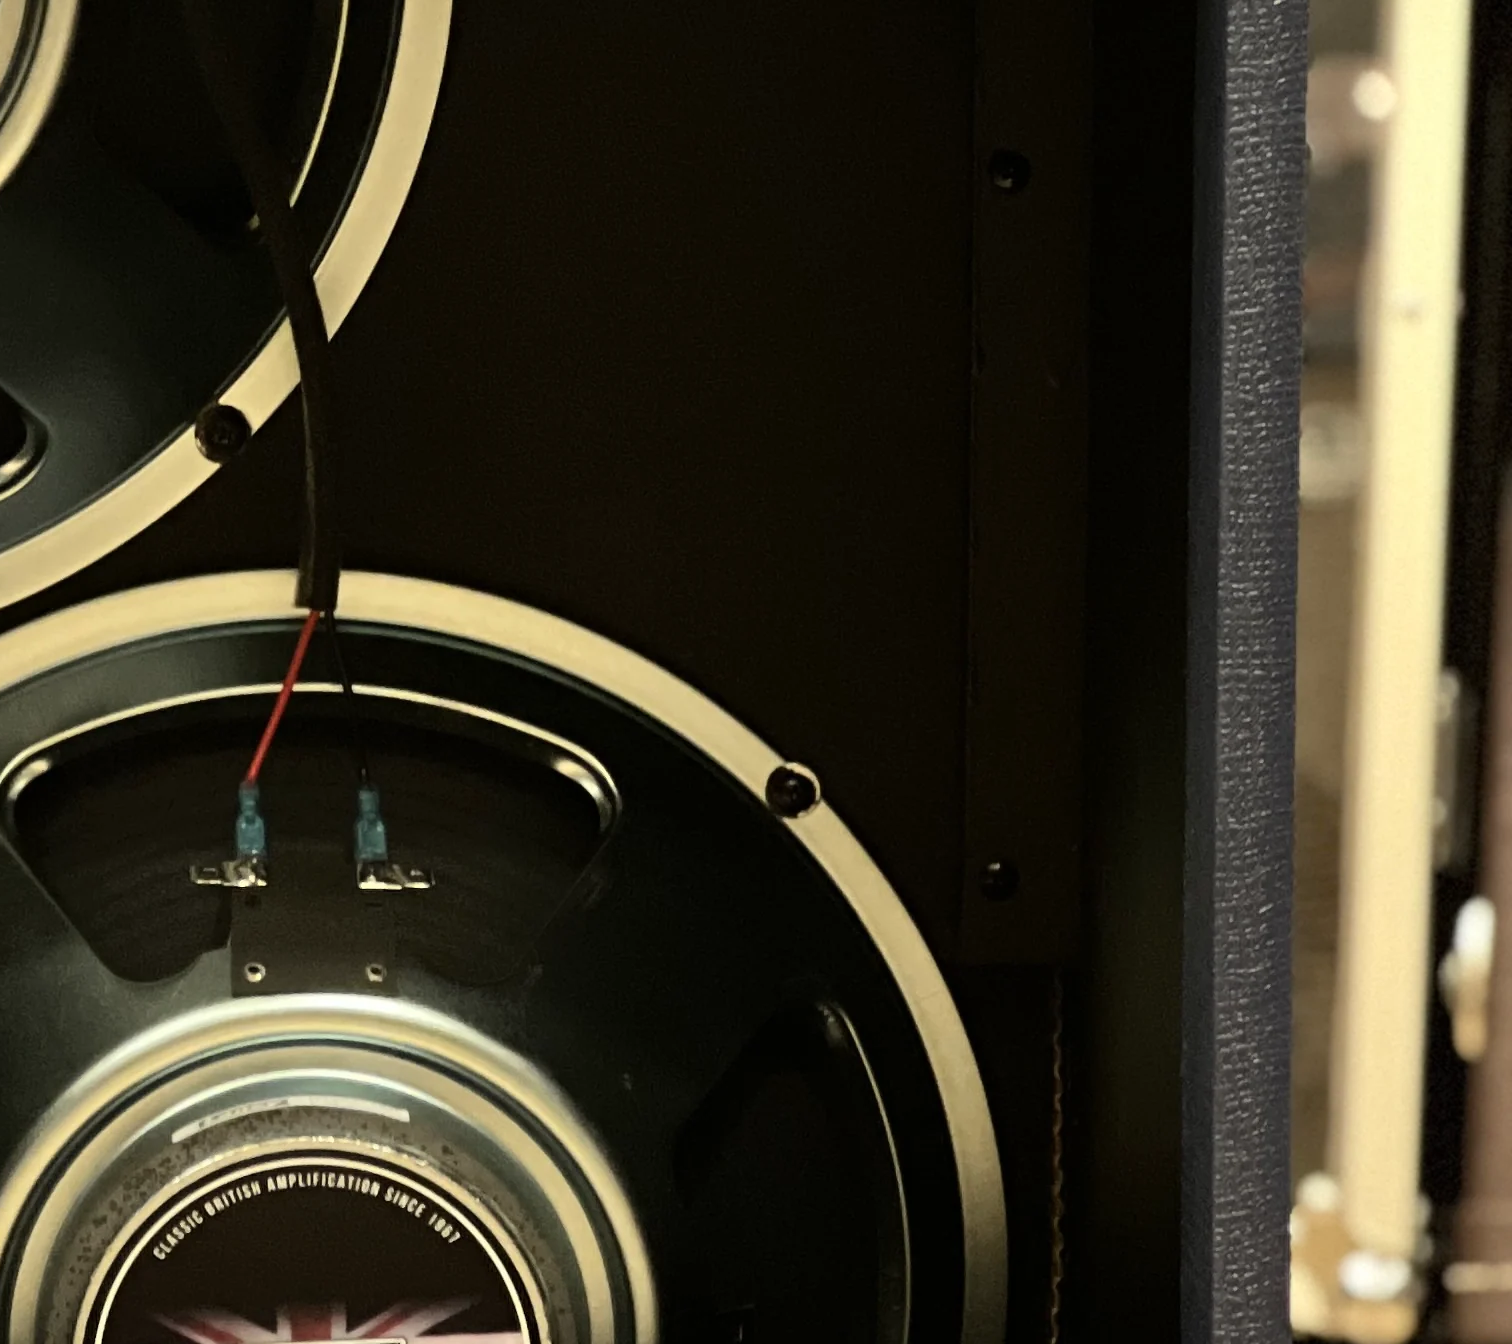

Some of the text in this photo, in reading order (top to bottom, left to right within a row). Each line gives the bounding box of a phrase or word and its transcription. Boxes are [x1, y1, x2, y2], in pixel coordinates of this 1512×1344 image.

[152, 1212, 204, 1261] CLASSIC
[204, 1182, 262, 1217] BRITISH
[266, 1172, 380, 1198] AMPLIFICATION
[383, 1186, 424, 1219] SINCE
